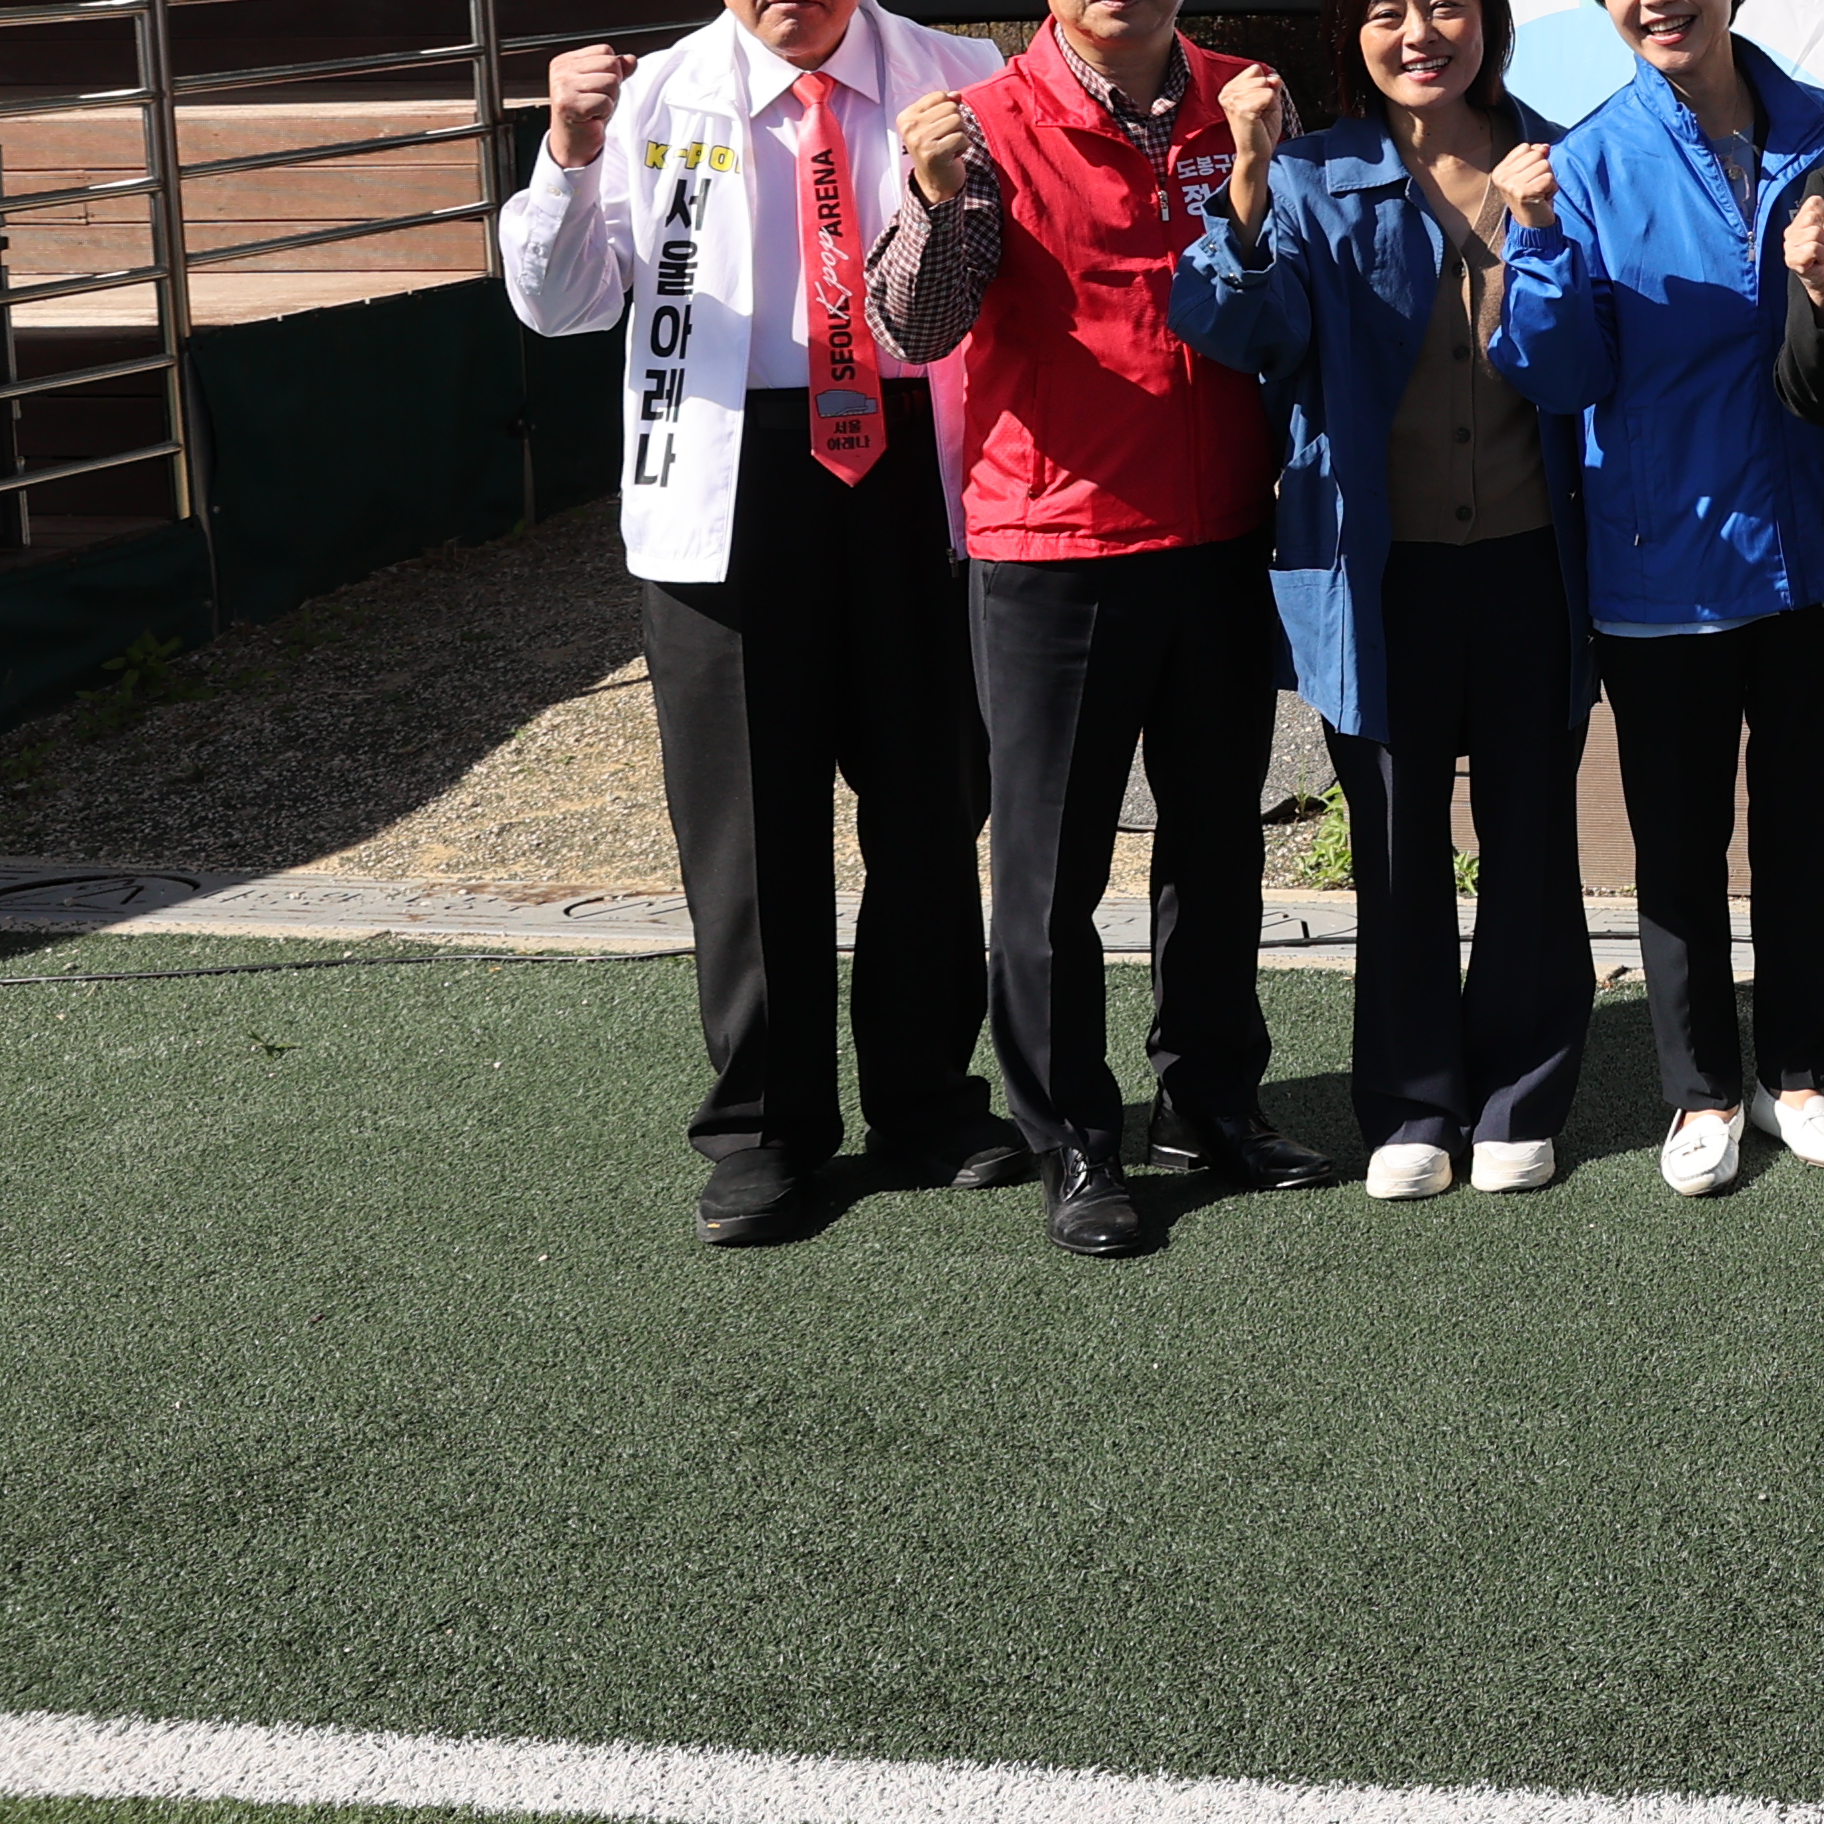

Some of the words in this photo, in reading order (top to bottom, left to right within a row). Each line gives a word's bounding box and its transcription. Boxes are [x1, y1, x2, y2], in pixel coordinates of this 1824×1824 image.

[644, 140, 742, 174] K-PO
[811, 147, 842, 237] ARENA
[634, 178, 712, 488] 서울아레나
[826, 434, 871, 451] 아레나
